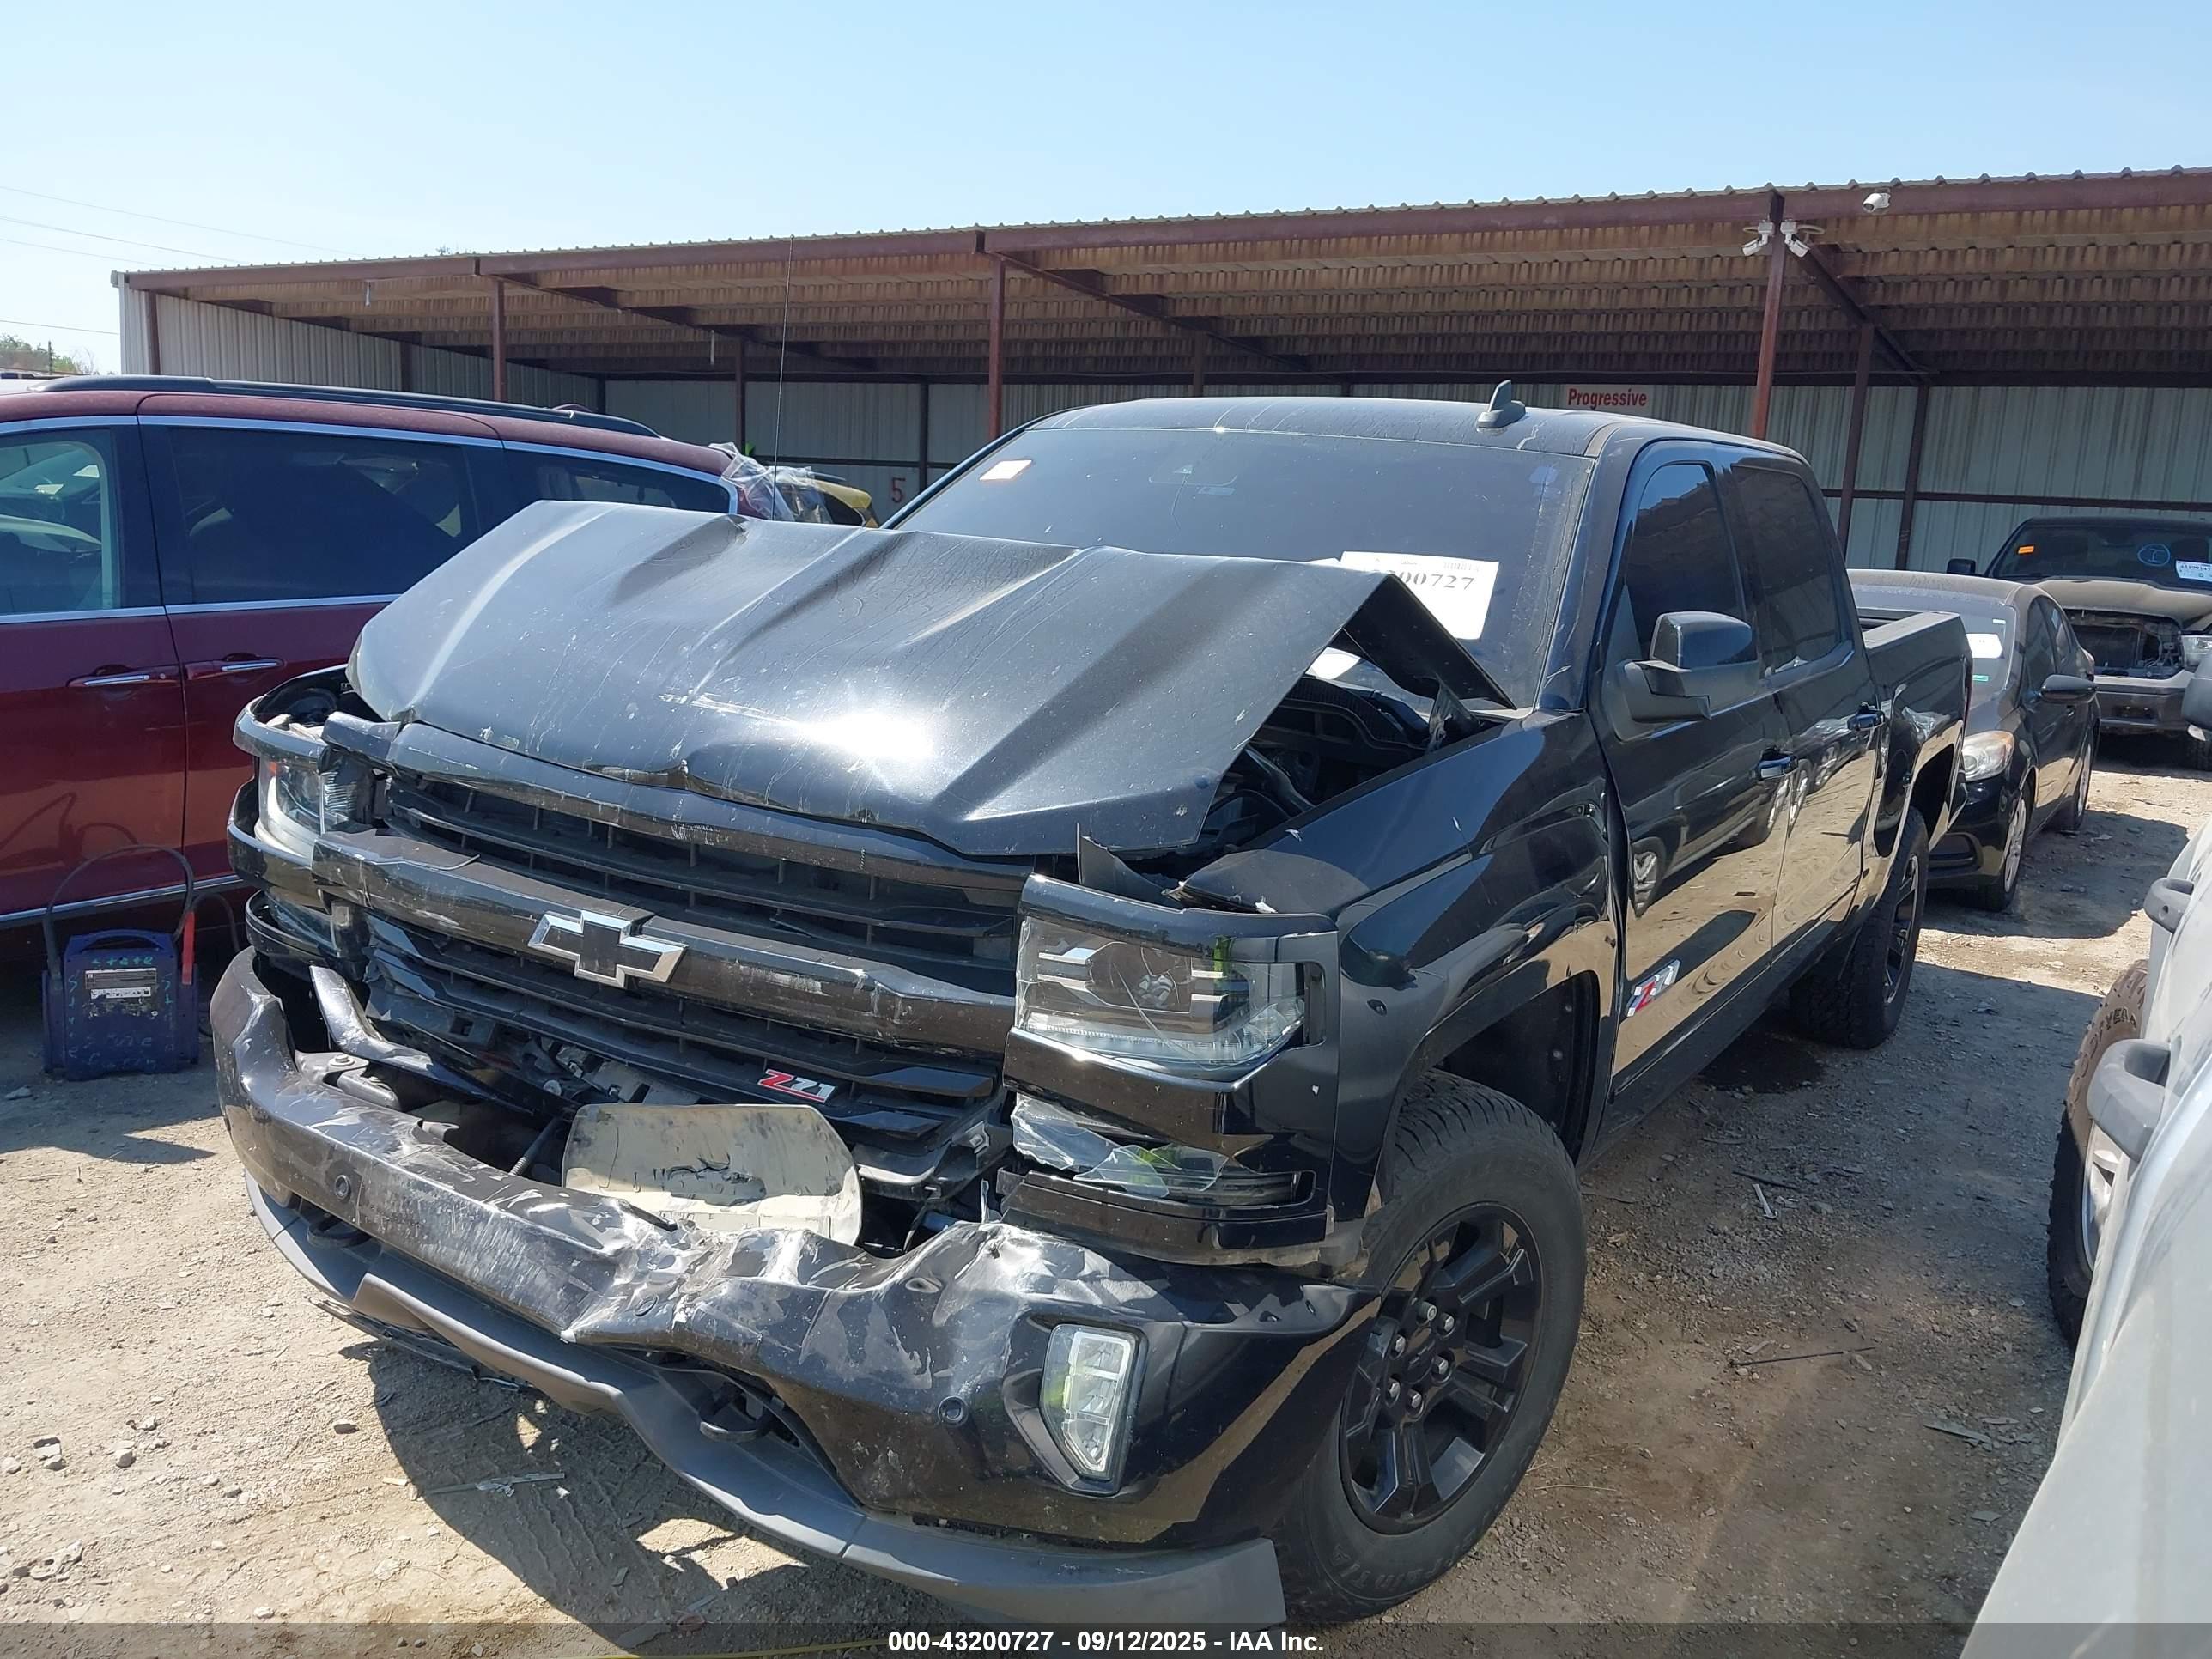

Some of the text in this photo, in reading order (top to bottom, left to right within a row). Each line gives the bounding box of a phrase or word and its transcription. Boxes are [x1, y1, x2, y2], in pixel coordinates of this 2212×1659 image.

[1568, 387, 1647, 410] Progressive
[891, 477, 906, 503] 5
[757, 1069, 836, 1103] Z71
